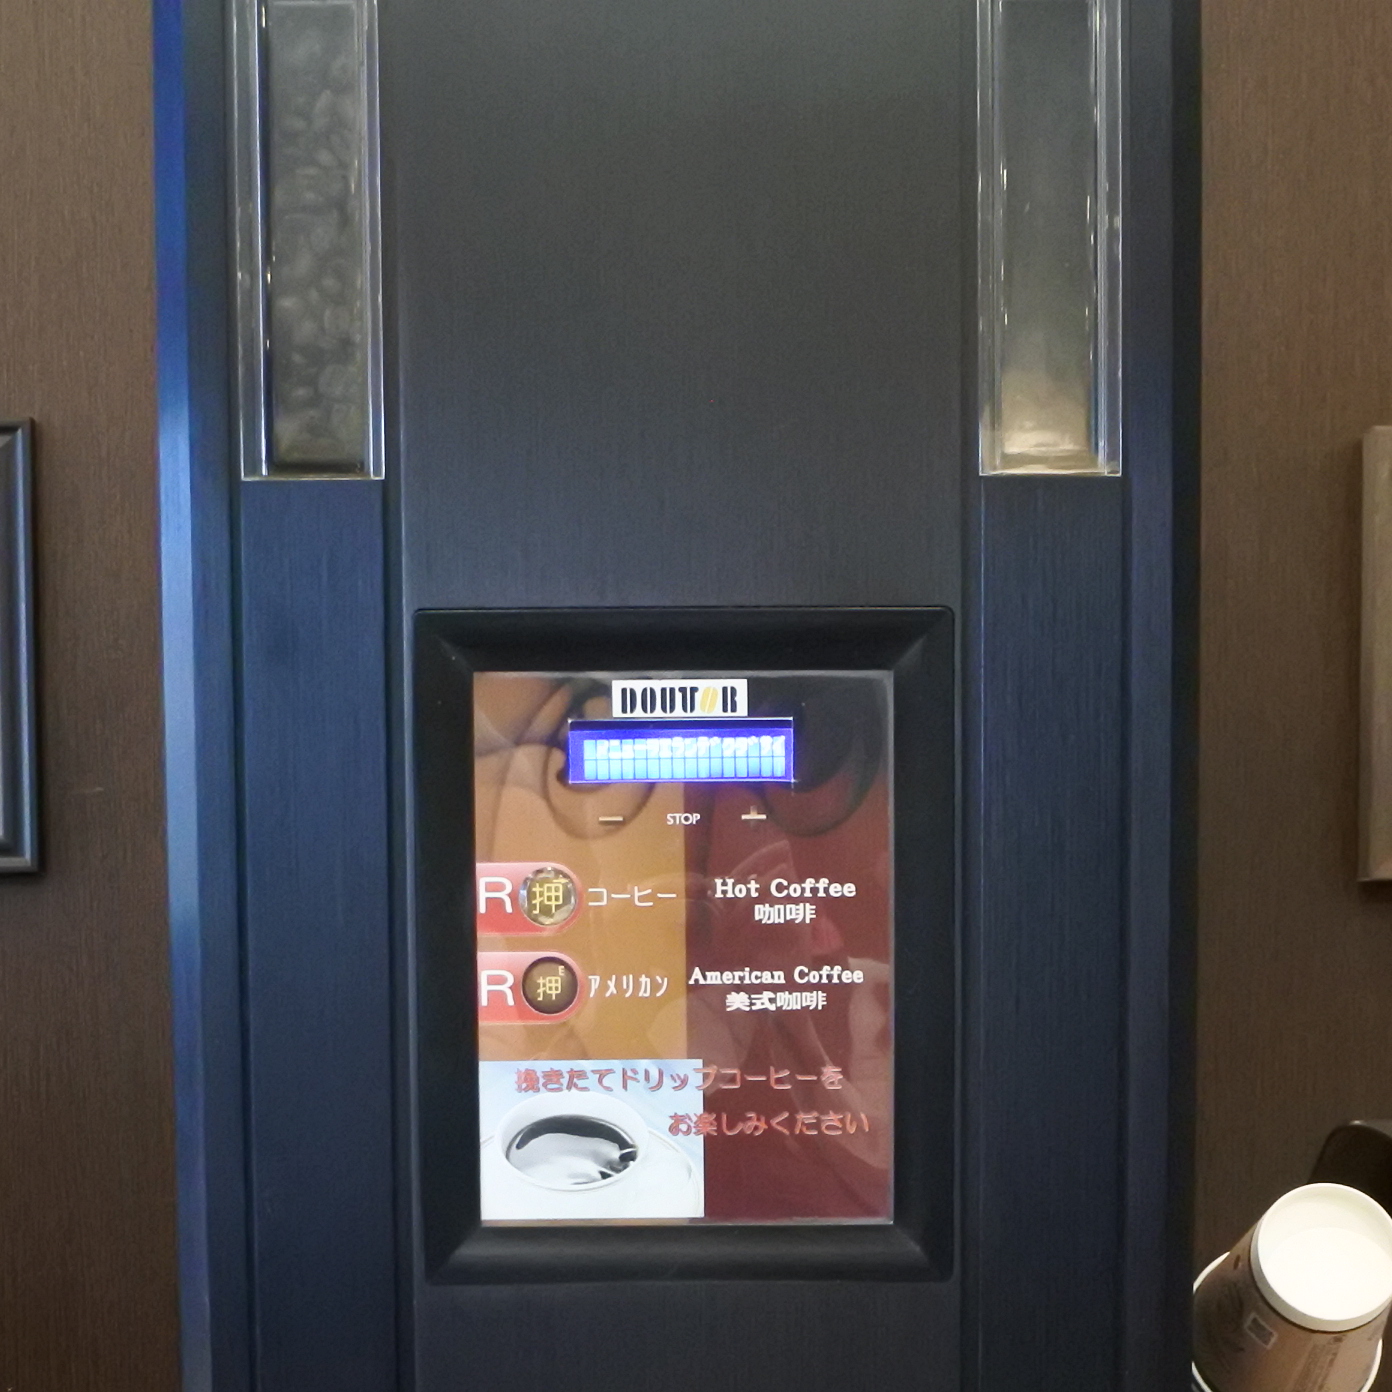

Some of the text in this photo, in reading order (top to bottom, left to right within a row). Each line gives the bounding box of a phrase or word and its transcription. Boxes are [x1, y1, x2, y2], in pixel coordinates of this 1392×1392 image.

[621, 686, 737, 714] DOUTOR
[666, 813, 700, 826] STOP
[479, 876, 677, 914] R 押 コーヒー
[715, 878, 856, 898] Hot Coffee
[754, 902, 816, 925] 咖啡
[689, 966, 864, 985] American Coffee
[481, 969, 668, 1007] R 押 アメリカン
[726, 990, 827, 1012] 美式咖啡
[514, 1066, 843, 1092] 挽きたてドリップコーヒーを
[668, 1112, 870, 1137] お楽しみください
